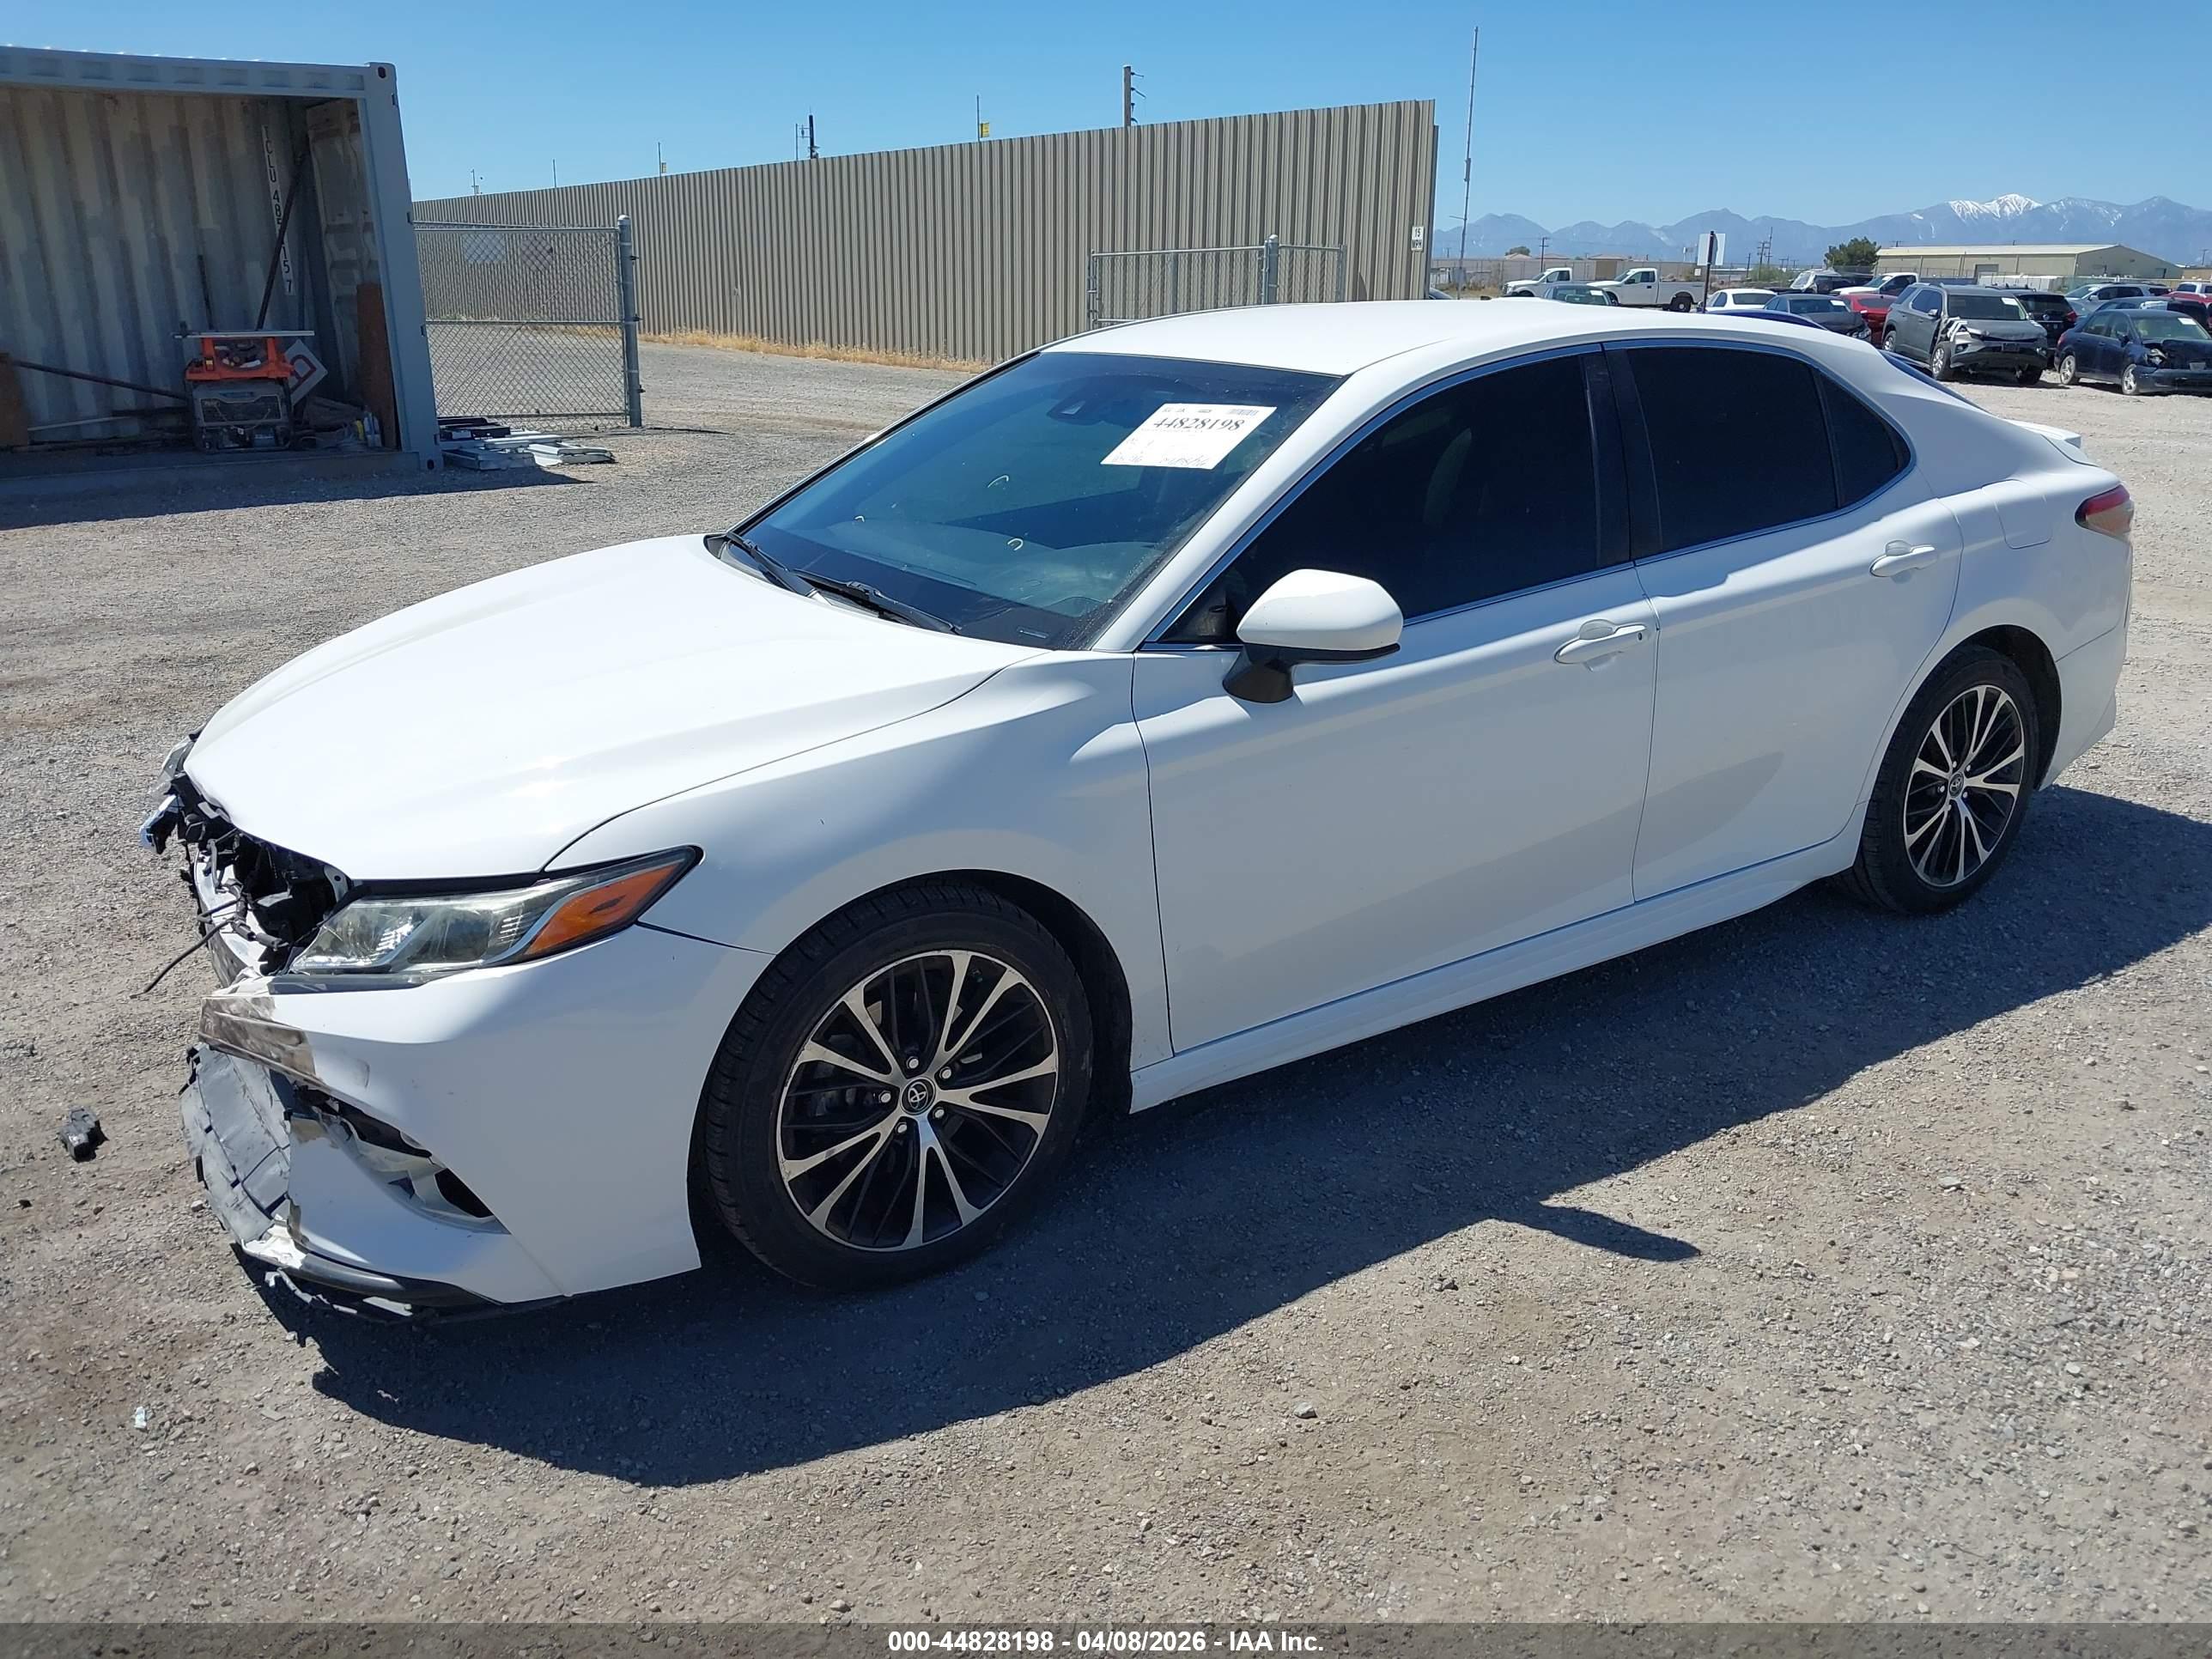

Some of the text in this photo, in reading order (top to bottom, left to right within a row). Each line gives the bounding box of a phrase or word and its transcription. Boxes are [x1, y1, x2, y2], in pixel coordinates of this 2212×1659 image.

[264, 125, 292, 293] TCLU 48515 7
[1153, 417, 1245, 431] 44828198
